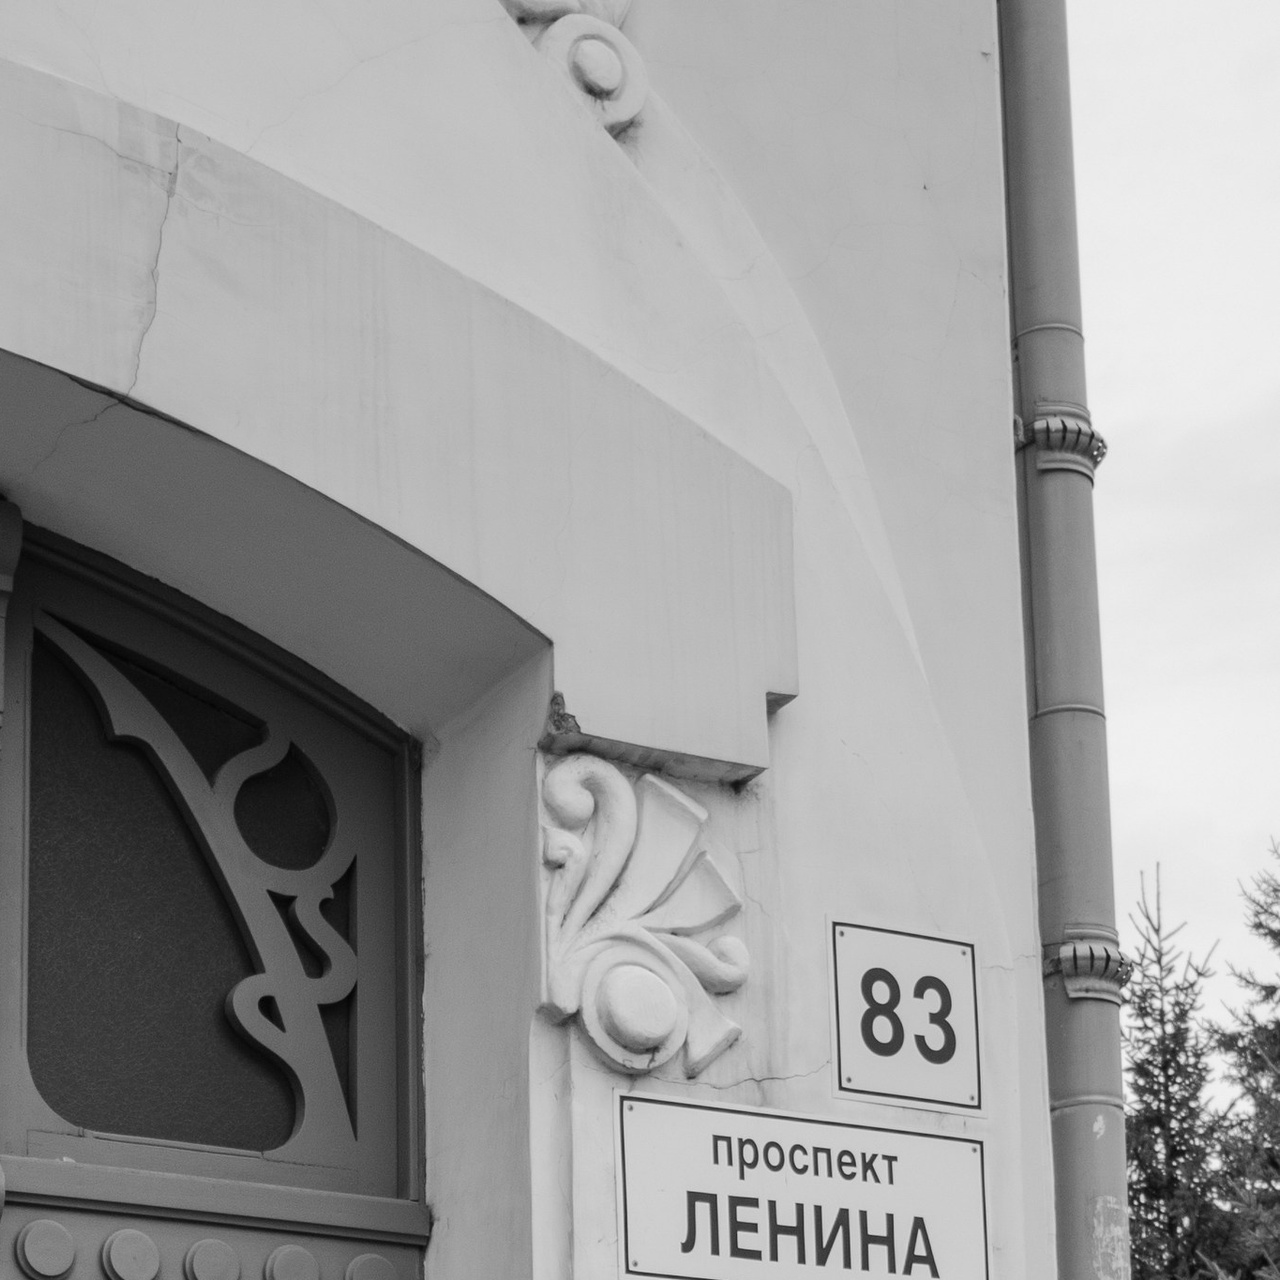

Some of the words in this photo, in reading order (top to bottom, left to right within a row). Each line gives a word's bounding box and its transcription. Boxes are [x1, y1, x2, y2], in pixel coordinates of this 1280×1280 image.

[860, 967, 957, 1065] 83
[712, 1134, 898, 1186] проспект
[680, 1190, 941, 1279] ЛЕНИНА
